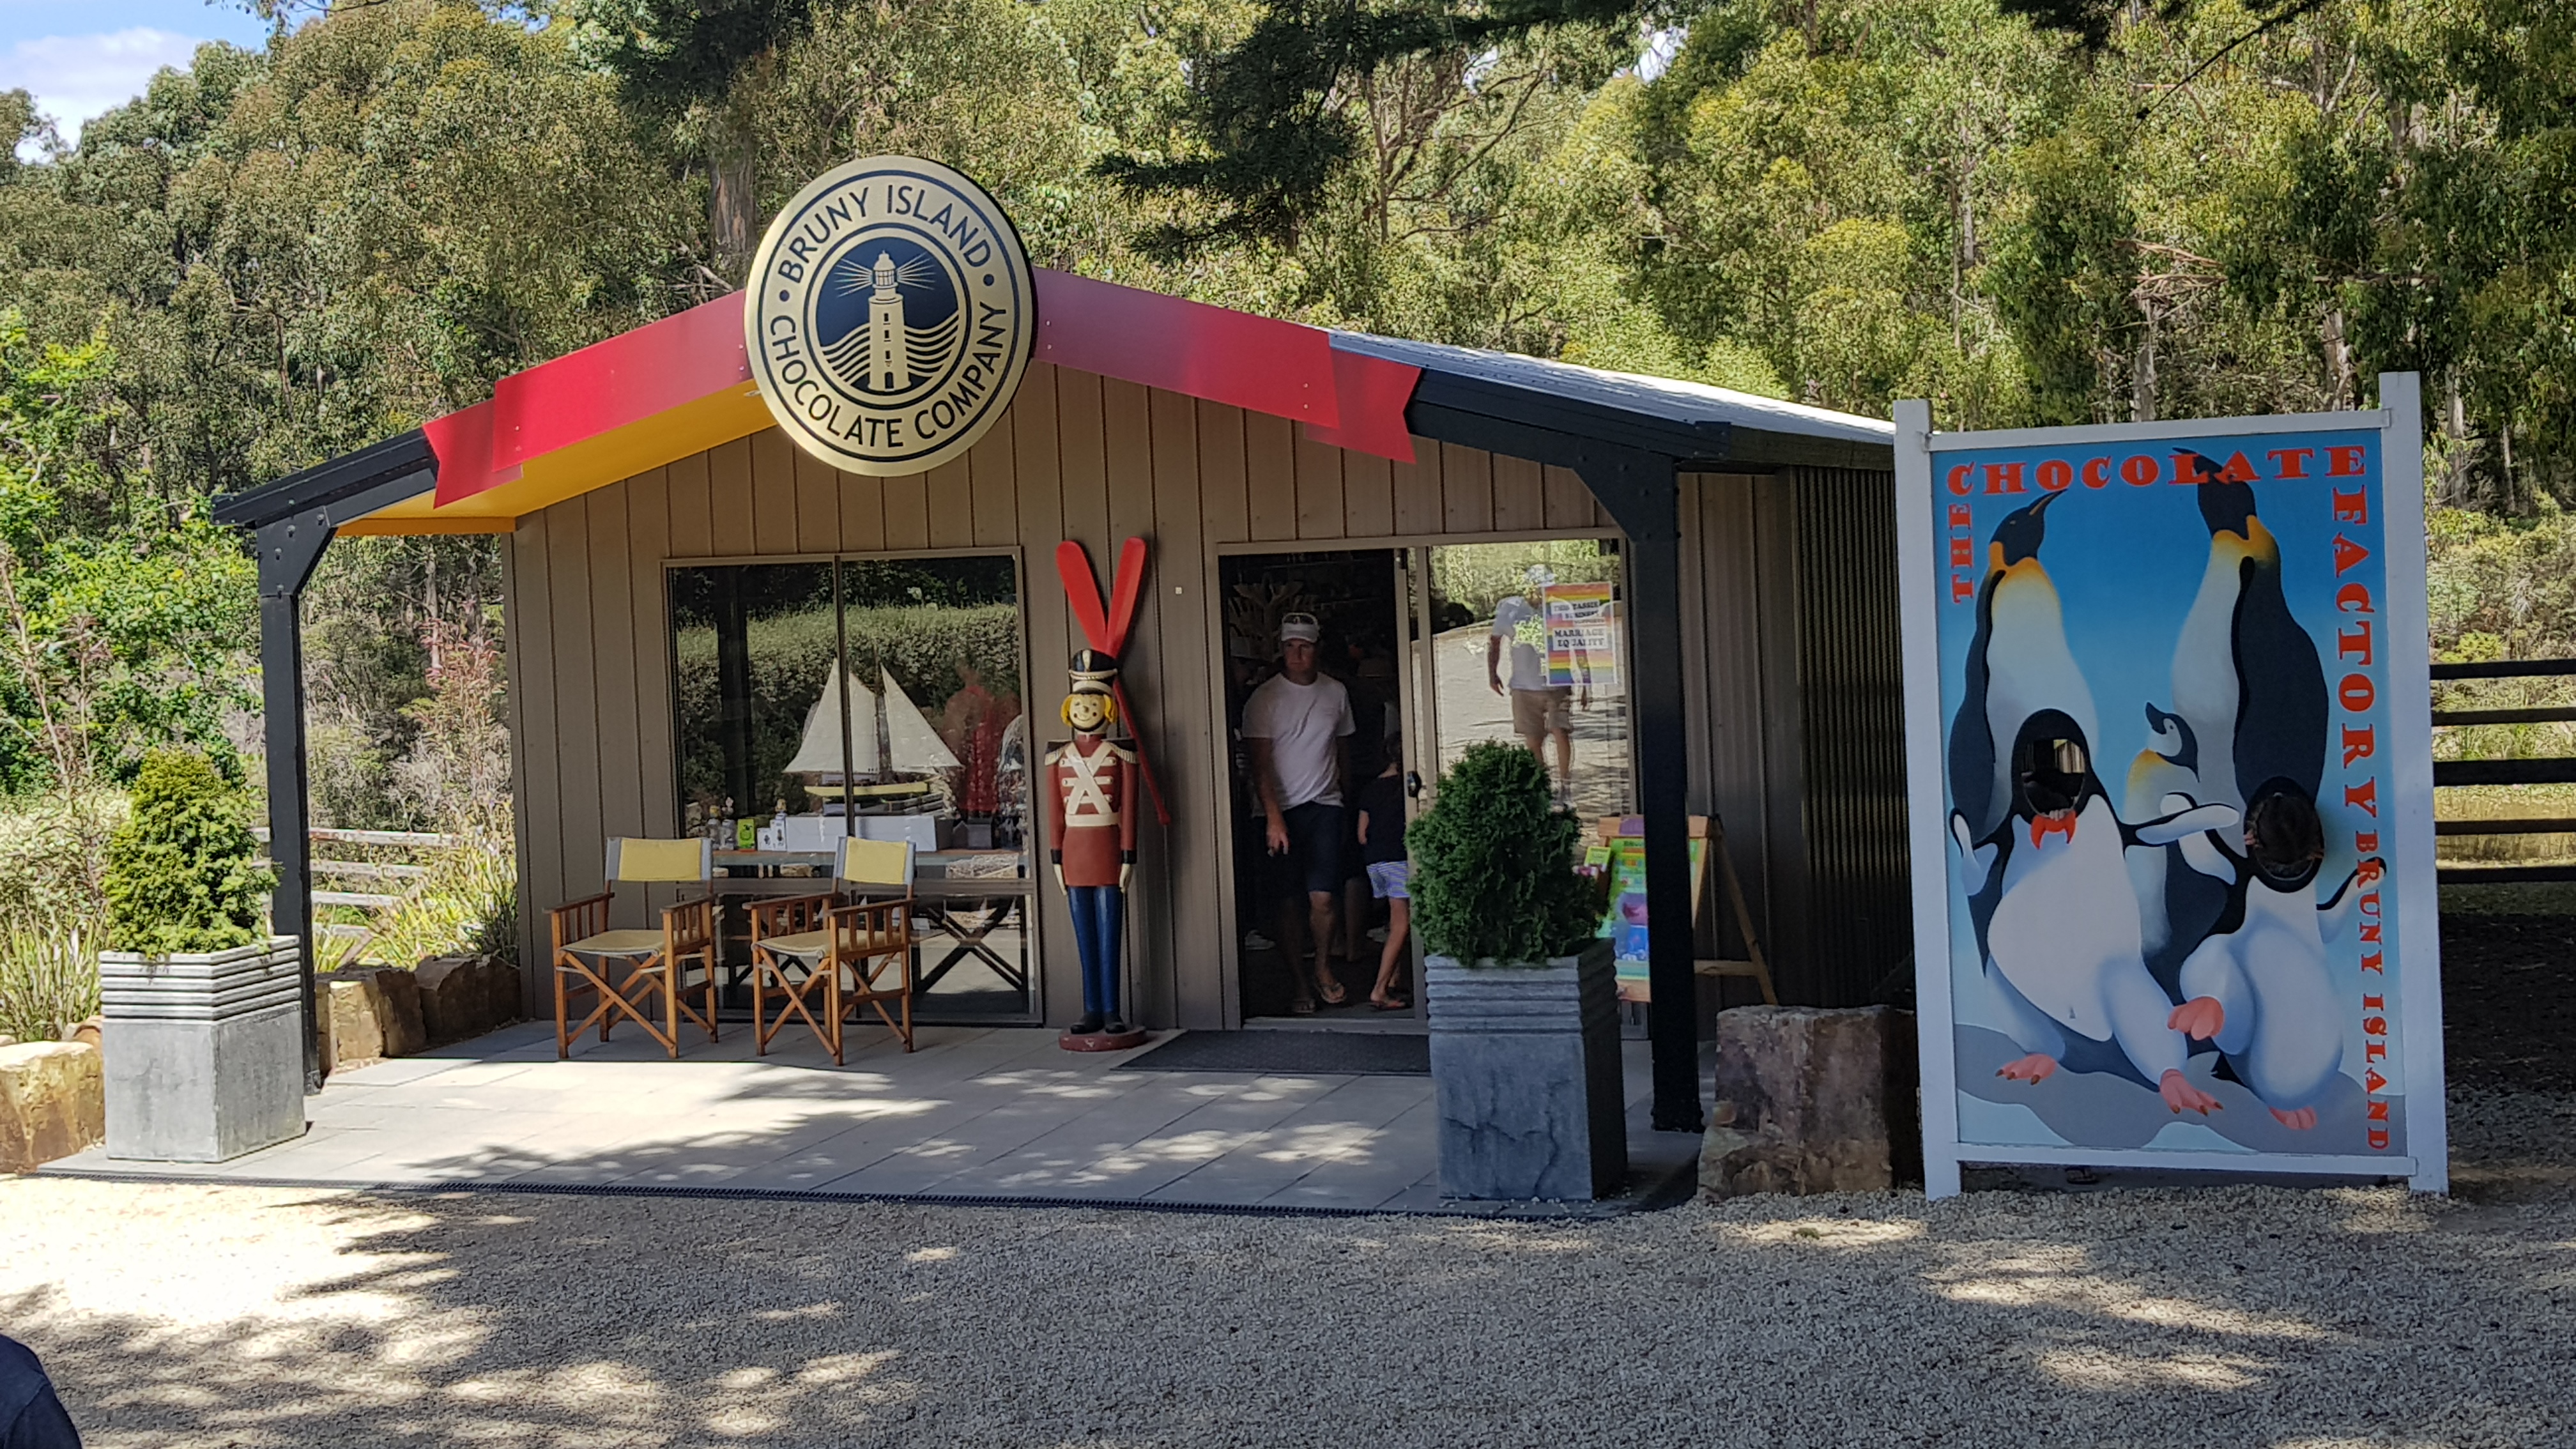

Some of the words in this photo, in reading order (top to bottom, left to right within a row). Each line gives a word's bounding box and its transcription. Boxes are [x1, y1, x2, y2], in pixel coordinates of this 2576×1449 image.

[778, 187, 869, 284] BRUNY
[887, 185, 992, 268] ISLAND
[770, 315, 903, 448] CHOCOLATE
[915, 301, 1007, 440] COMPANY
[1947, 445, 2366, 496] CHOCOLATE
[1948, 503, 1974, 604] THE
[1554, 628, 1604, 637] MARRIAGE
[2332, 486, 2377, 818] FACTORY
[2356, 830, 2385, 975] BRUNY
[2363, 993, 2389, 1149] ISLAND
